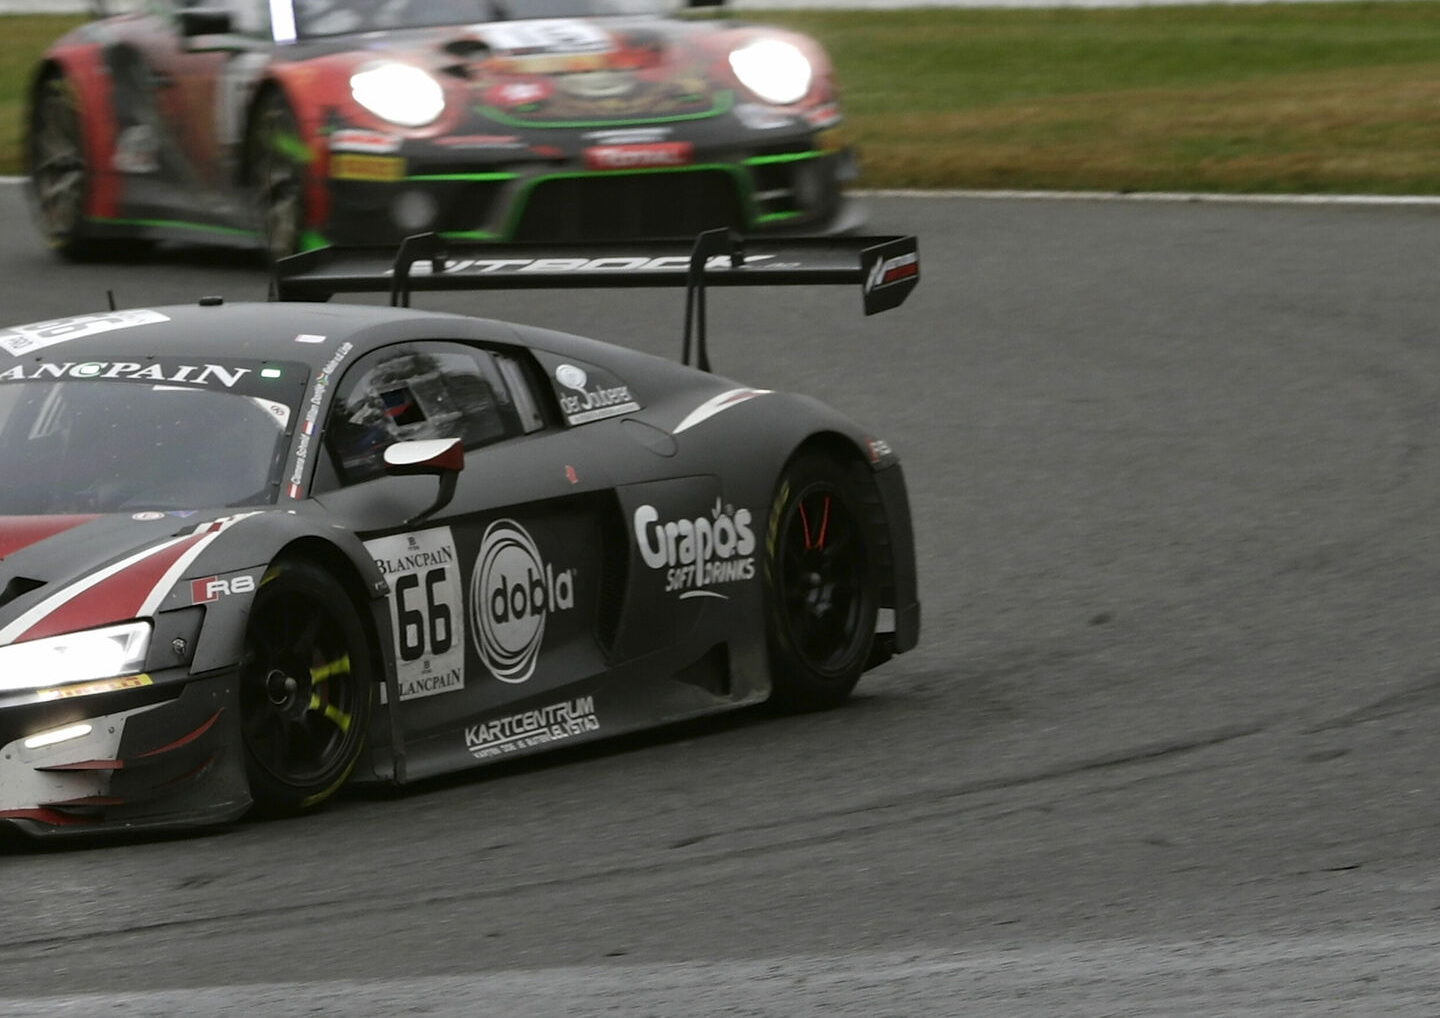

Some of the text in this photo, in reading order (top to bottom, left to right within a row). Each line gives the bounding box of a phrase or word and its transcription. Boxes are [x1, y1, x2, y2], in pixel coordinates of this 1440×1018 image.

[375, 546, 453, 575] BLANCPAIN
[703, 557, 755, 584] DRINKS
[206, 575, 255, 599] R8
[491, 561, 574, 624] dobla
[396, 567, 452, 662] 66
[399, 668, 461, 696] LANCPAIN
[464, 696, 595, 747] KARTCENTRUM
